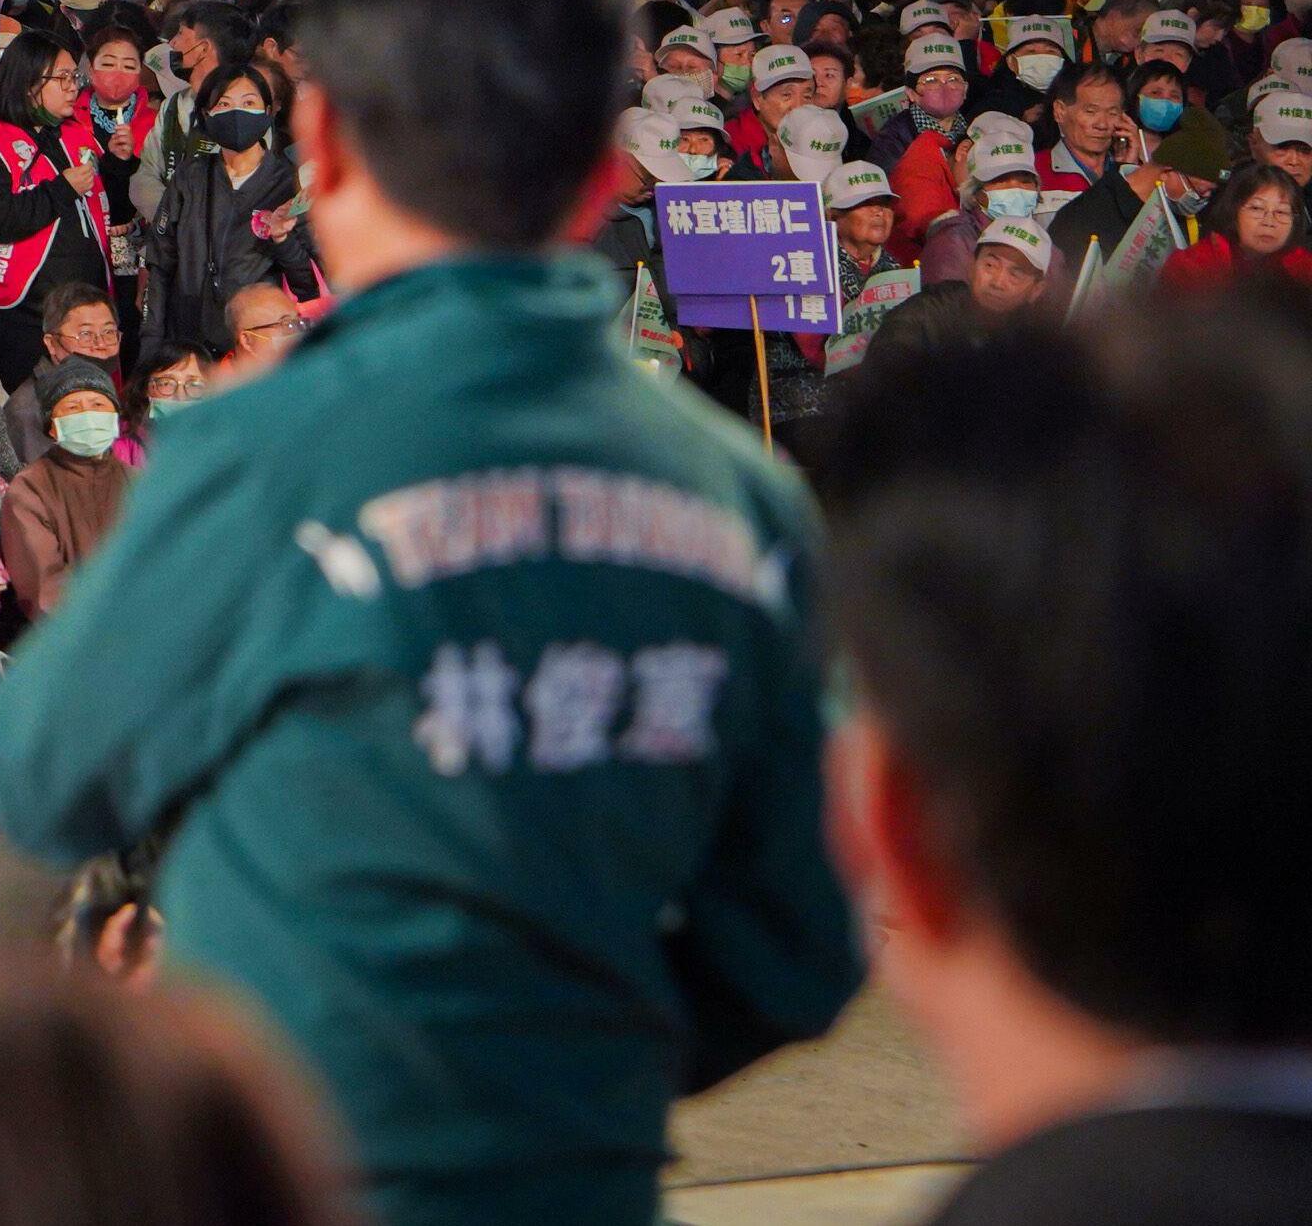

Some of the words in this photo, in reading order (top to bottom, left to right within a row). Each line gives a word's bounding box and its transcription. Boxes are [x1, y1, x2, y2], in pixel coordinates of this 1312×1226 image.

[848, 173, 882, 186] 林俊憲
[666, 199, 810, 235] 林宜瑾/歸仁
[771, 250, 817, 286] 2車
[784, 294, 828, 324] 1車
